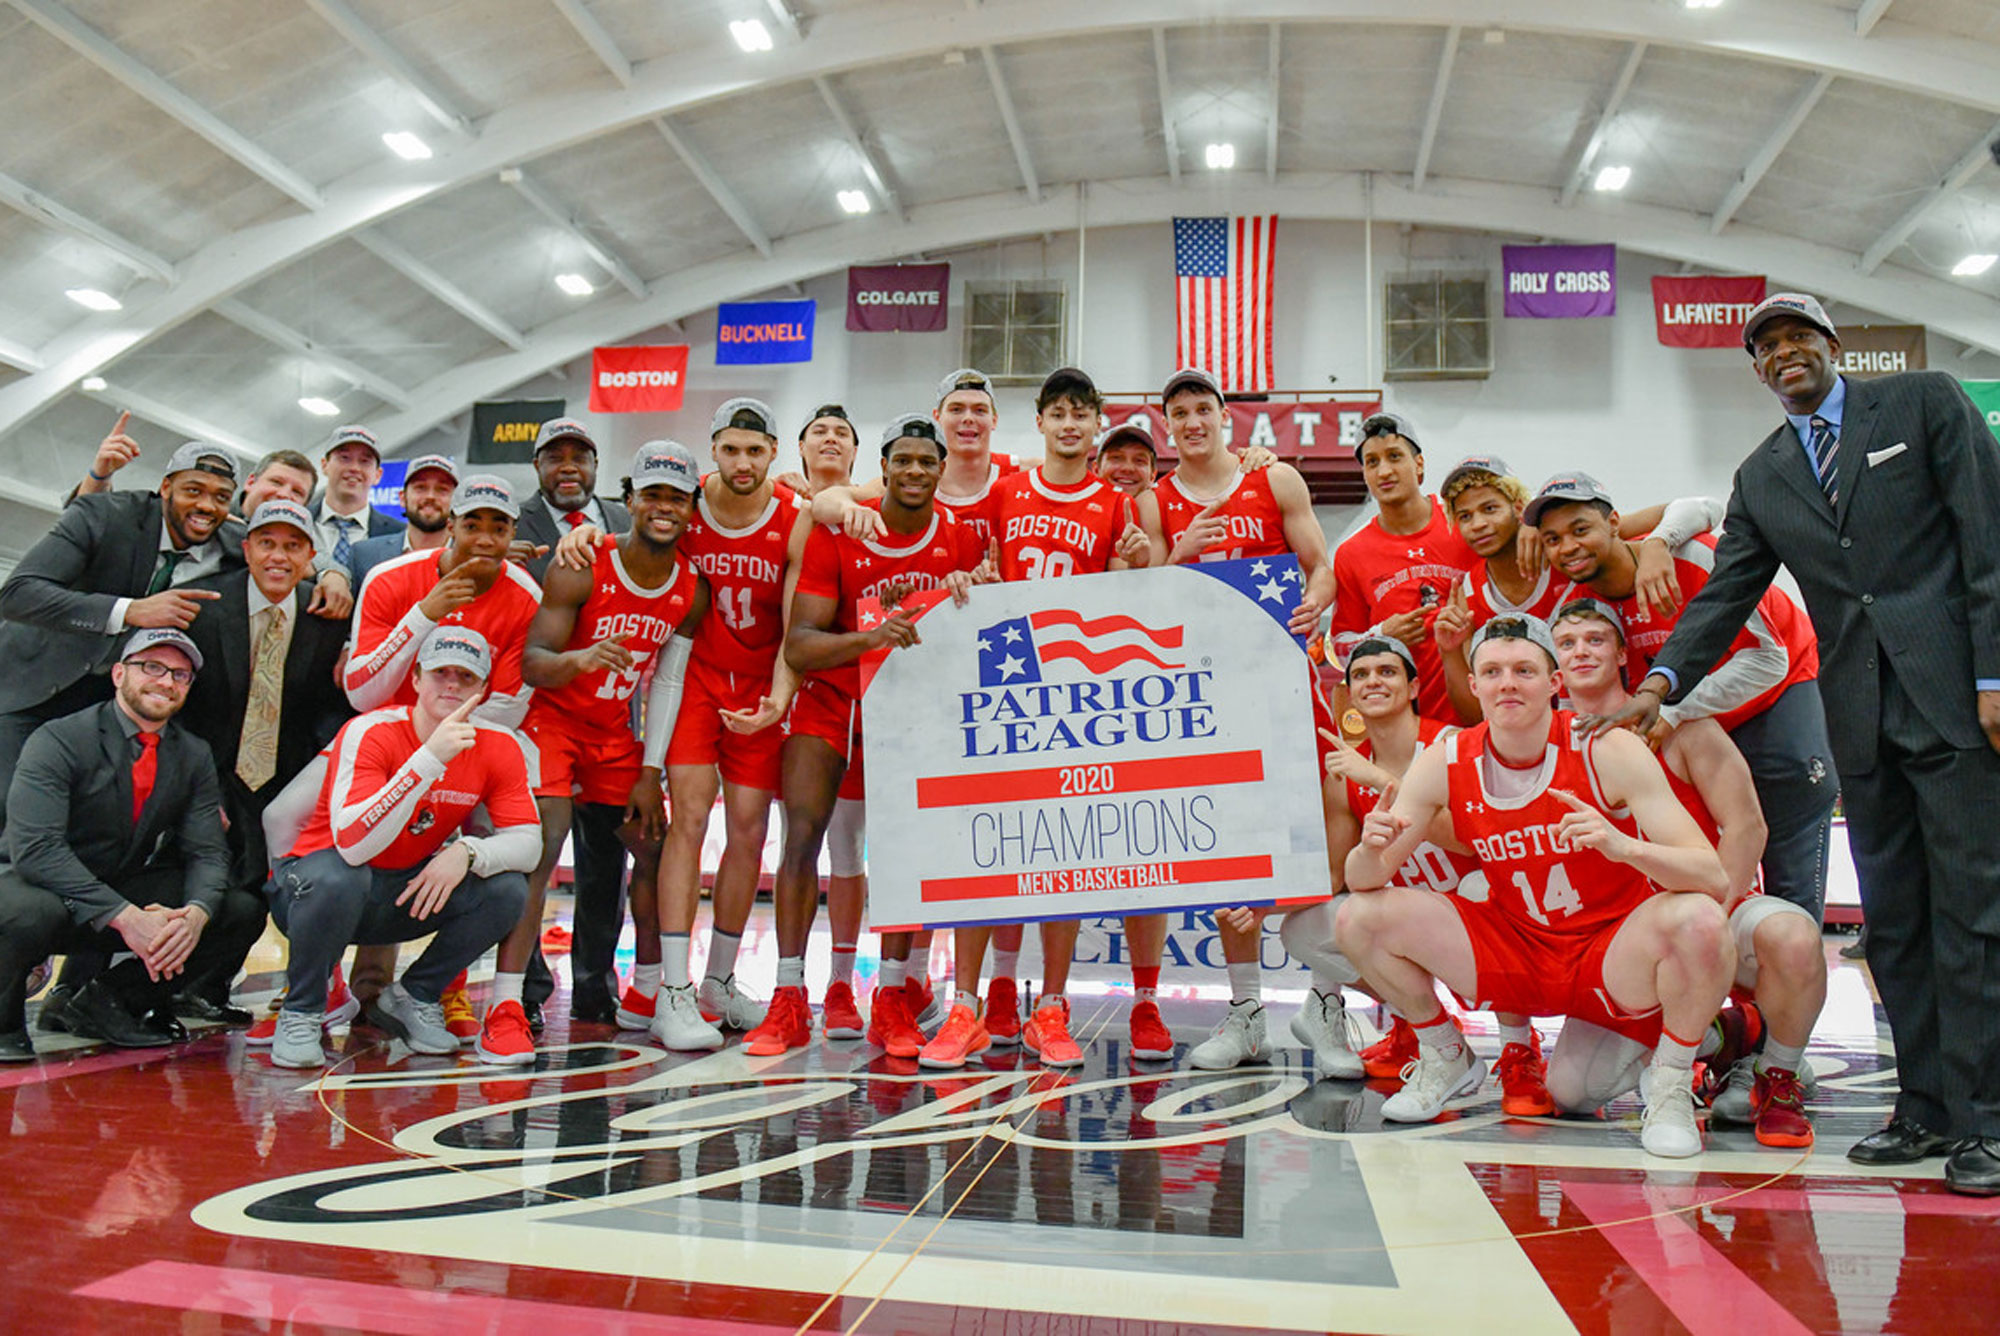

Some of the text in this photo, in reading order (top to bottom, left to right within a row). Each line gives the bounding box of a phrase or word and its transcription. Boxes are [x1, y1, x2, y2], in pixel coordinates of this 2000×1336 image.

[856, 290, 940, 305] COLGATE
[1510, 270, 1611, 293] HOLY CROSS
[720, 323, 806, 343] BUCKNELL
[598, 370, 678, 387] BOSTON
[1836, 351, 1907, 372] LEHIGH
[493, 422, 541, 442] ARMY
[1004, 514, 1098, 557] BOSTON
[1017, 546, 1074, 580] 30
[717, 586, 756, 630] 11
[366, 630, 409, 675] TERRIERS
[958, 670, 1213, 724] PATRIOT
[960, 705, 1218, 758] LEAGUE
[1058, 765, 1115, 795] 2020
[360, 775, 416, 829] TERRIERS
[971, 794, 1217, 868] CHAMPIONS
[1017, 863, 1179, 895] MEN'S BASKETBALL
[1511, 862, 1584, 927] 14
